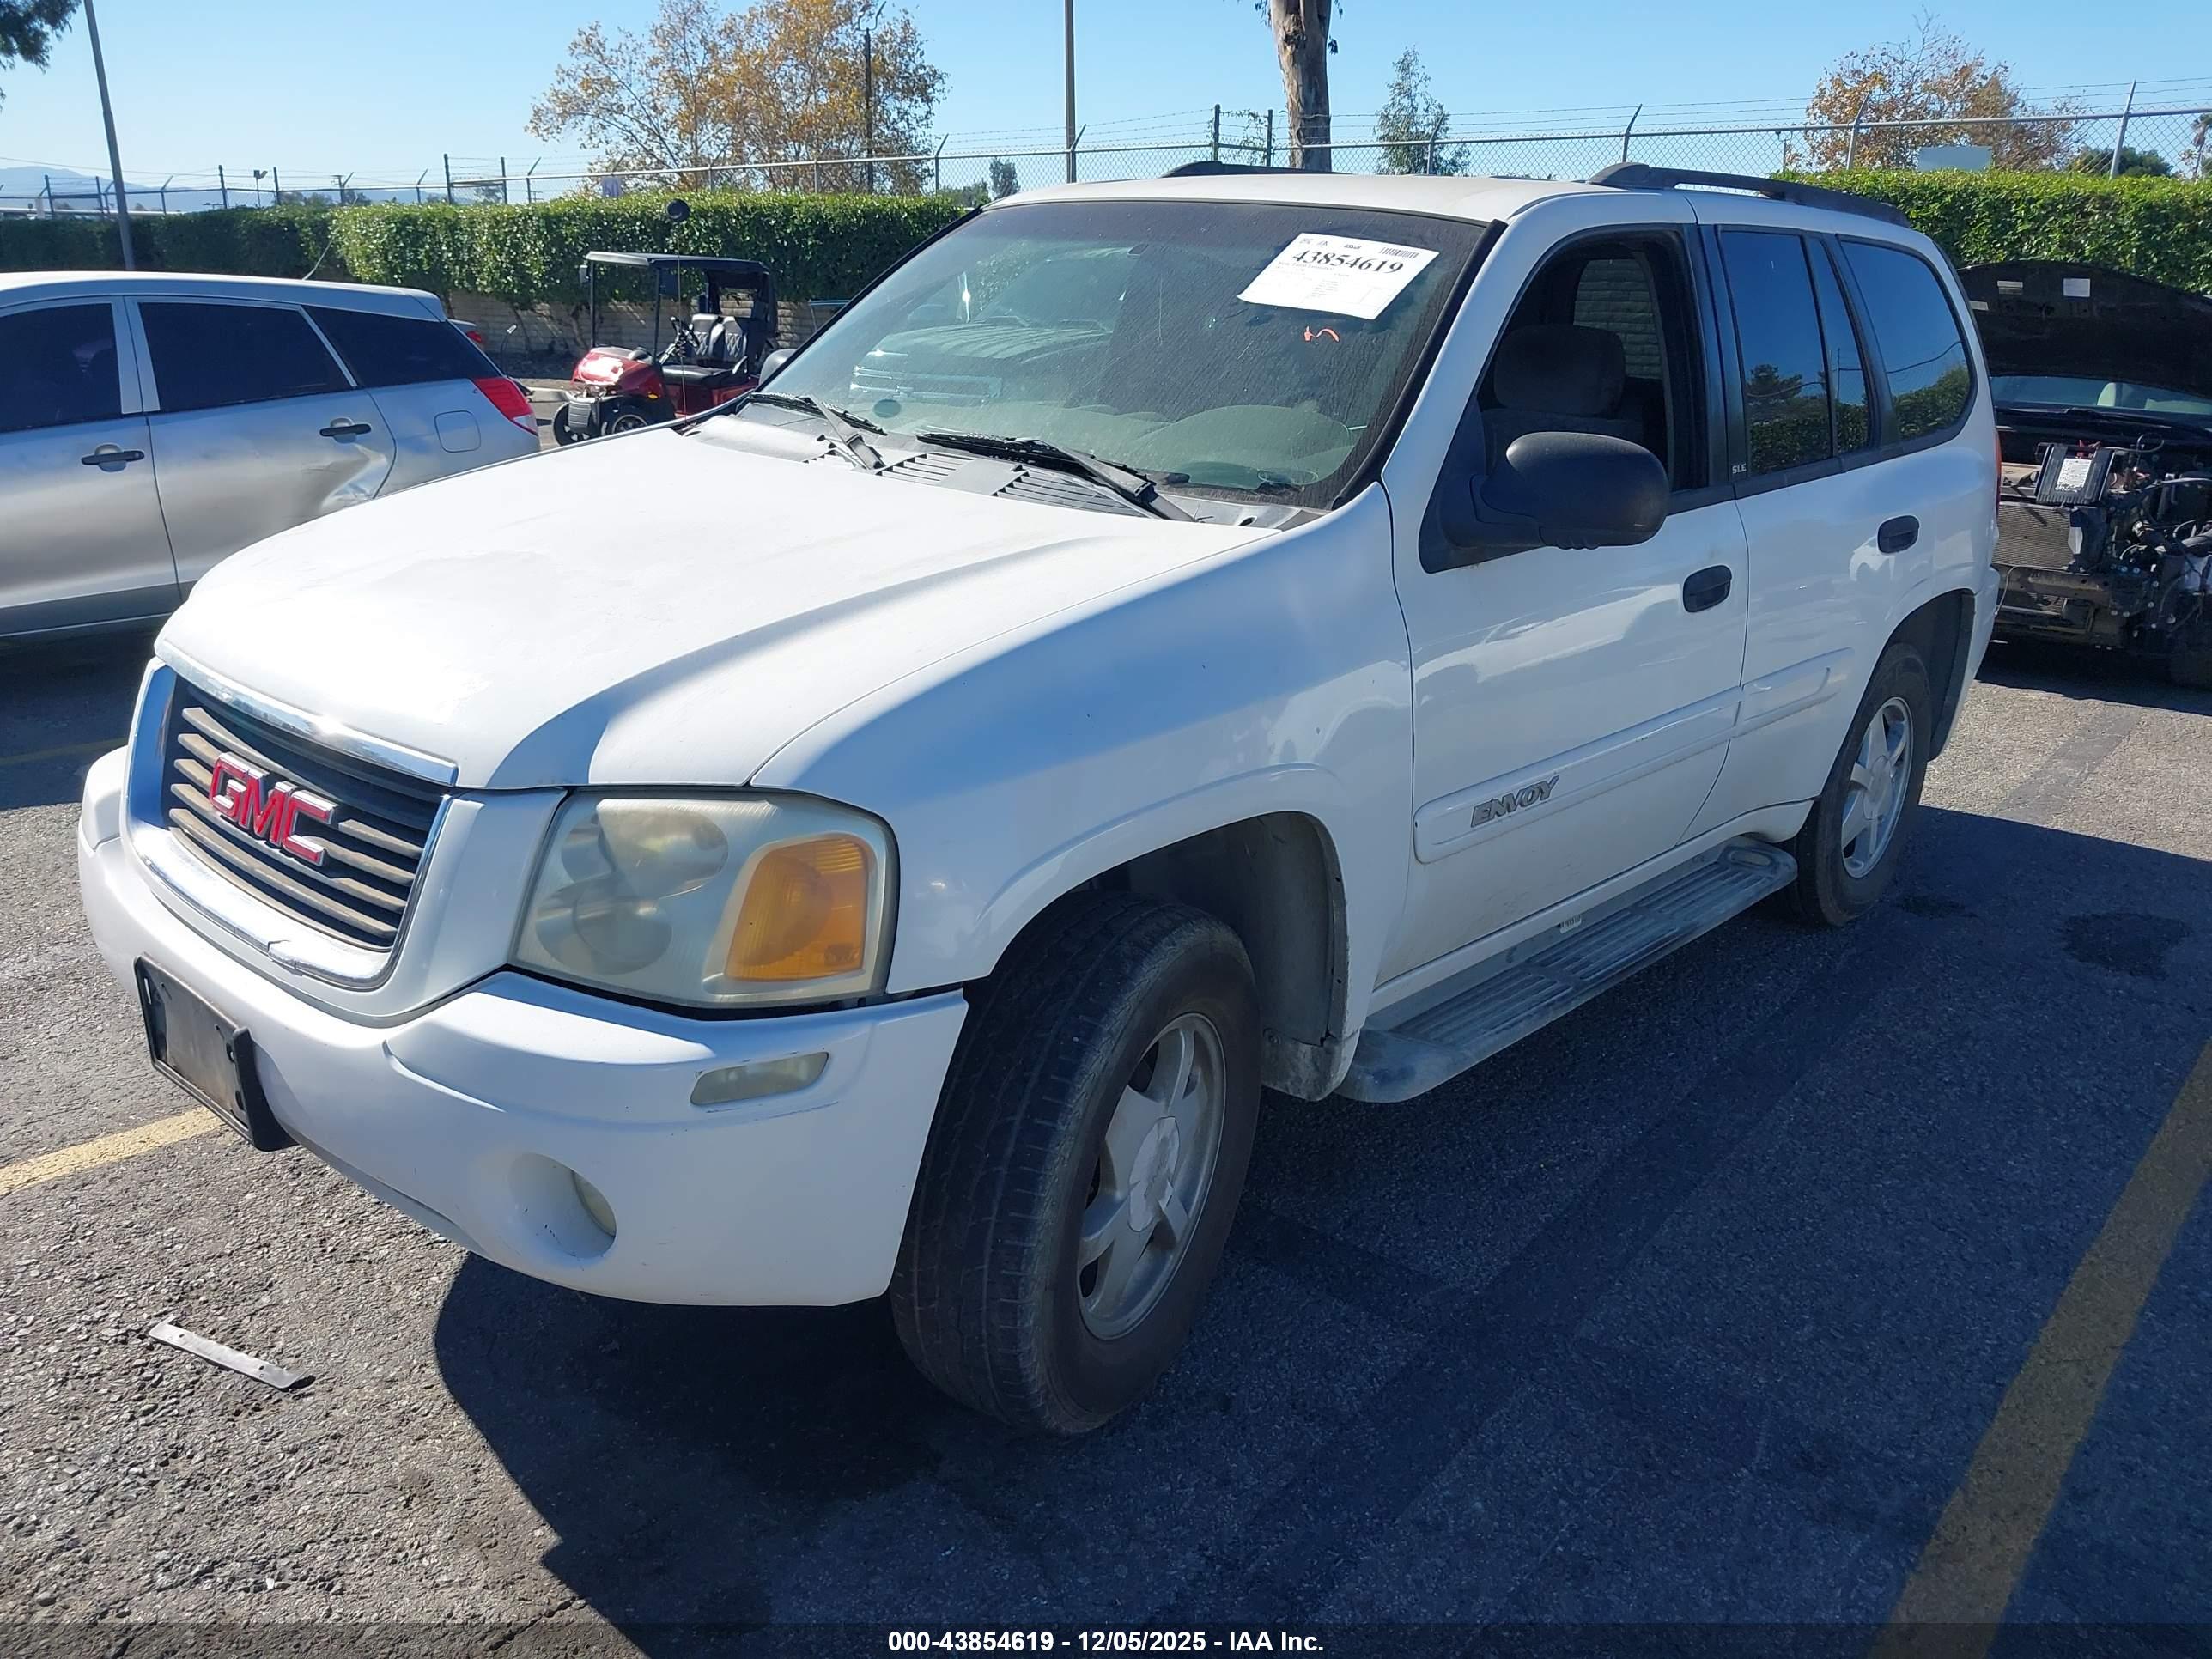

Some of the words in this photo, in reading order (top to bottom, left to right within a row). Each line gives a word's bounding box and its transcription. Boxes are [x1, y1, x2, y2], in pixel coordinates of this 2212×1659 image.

[1291, 249, 1404, 274] 43854619
[1732, 462, 1747, 474] SLE
[209, 751, 339, 866] GMC
[1470, 775, 1560, 828] ENVOY
